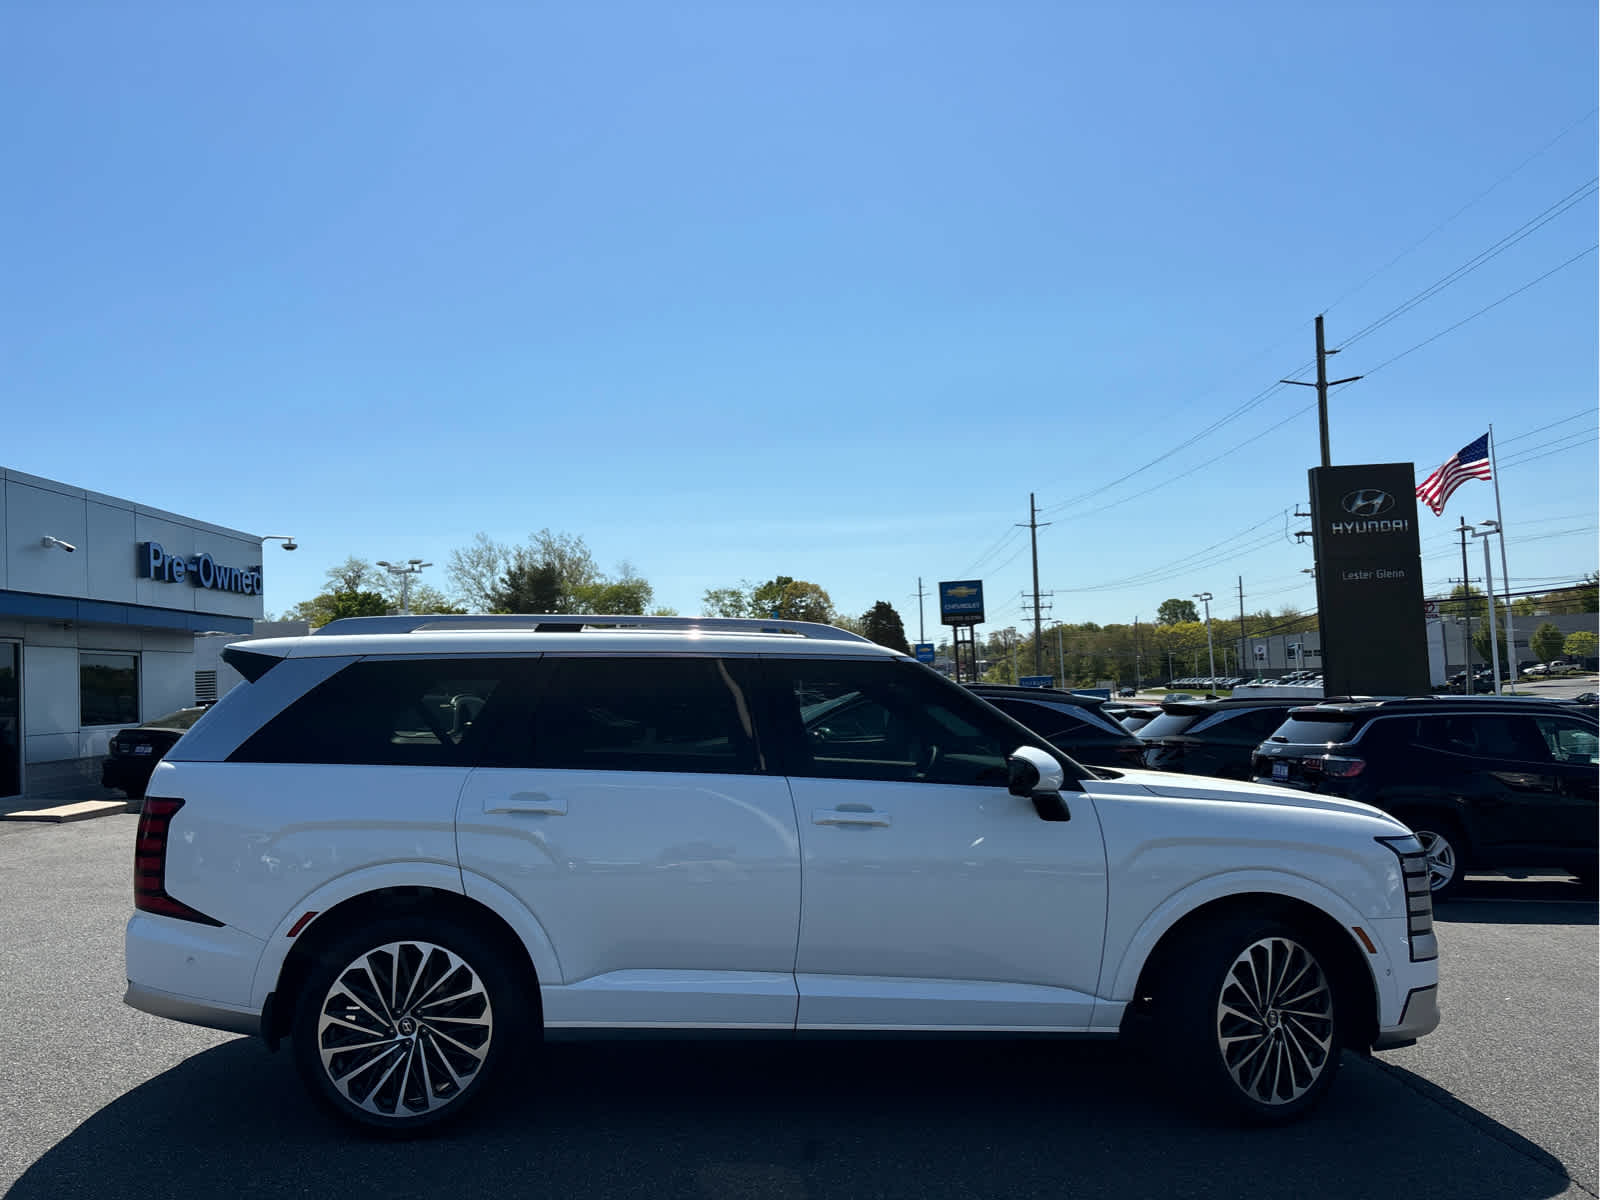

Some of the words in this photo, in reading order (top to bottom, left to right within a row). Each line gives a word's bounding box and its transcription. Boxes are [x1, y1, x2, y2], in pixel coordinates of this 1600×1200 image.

[1332, 520, 1409, 534] HYUNDAI
[145, 541, 263, 595] Pre-Owned
[1342, 570, 1373, 580] Lester
[1375, 568, 1405, 579] Glenn
